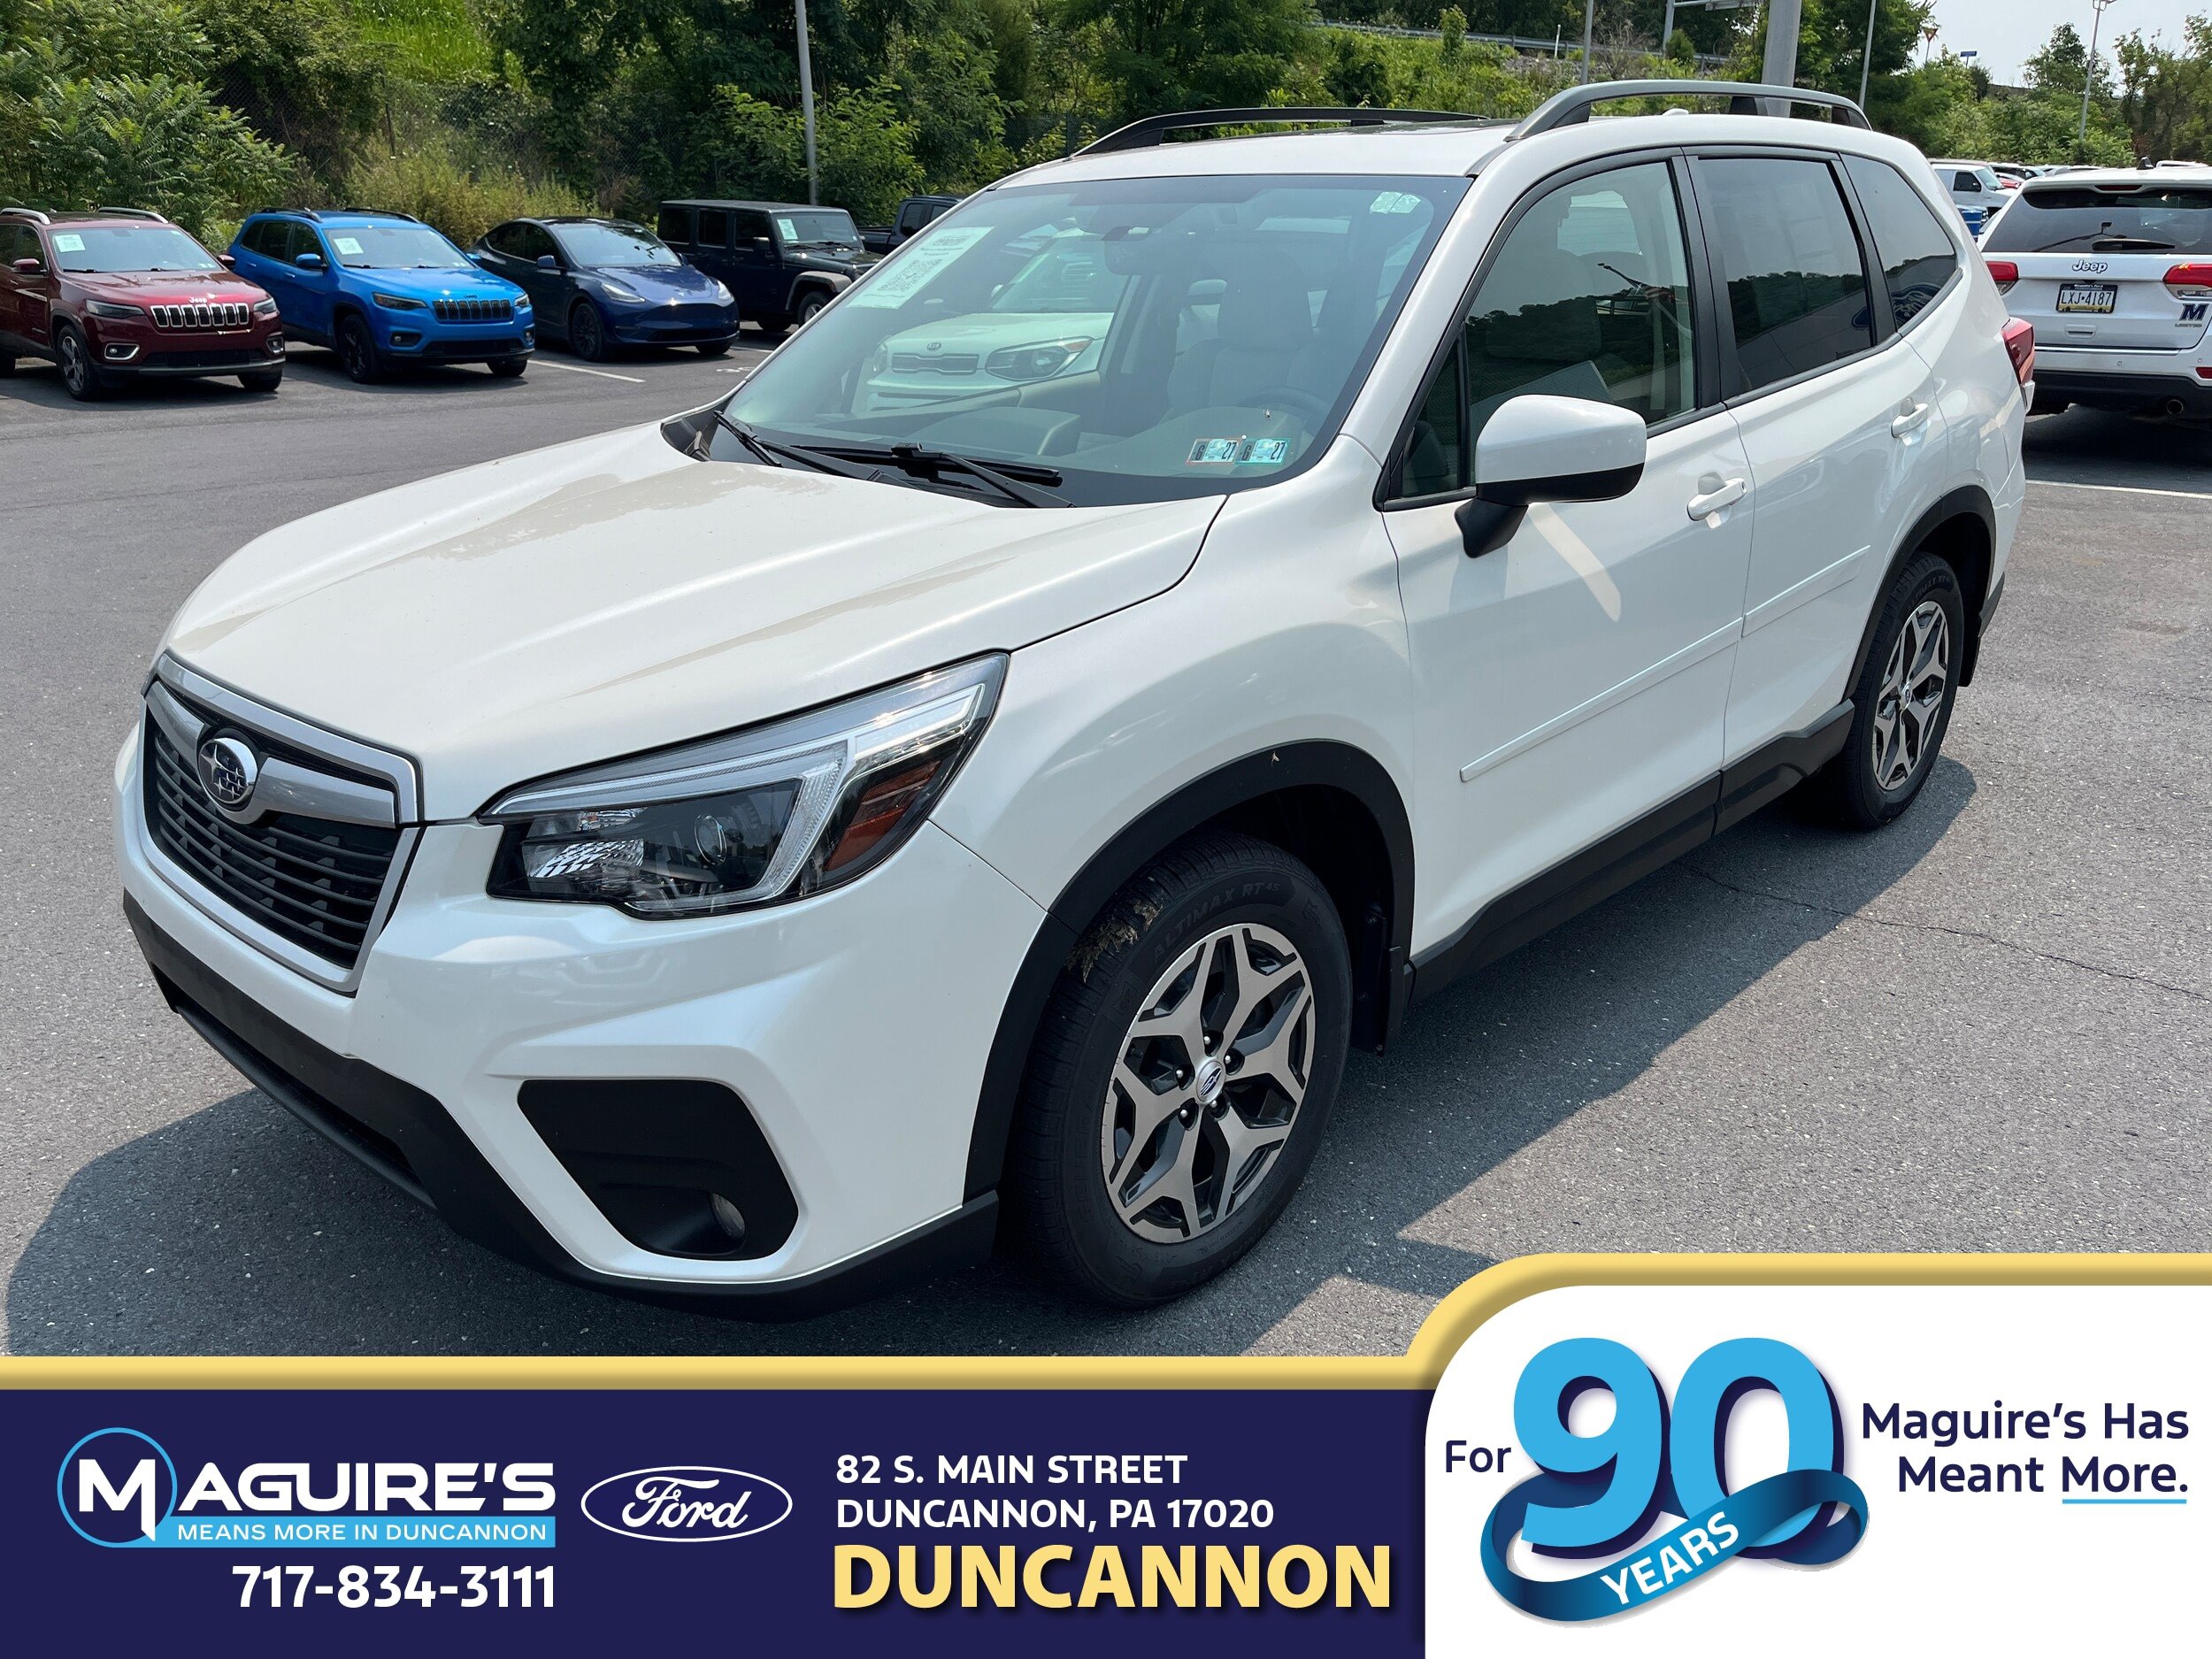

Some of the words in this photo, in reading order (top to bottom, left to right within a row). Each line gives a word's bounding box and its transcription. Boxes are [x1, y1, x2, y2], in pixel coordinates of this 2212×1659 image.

[2072, 260, 2108, 273] Jeep
[2179, 303, 2209, 320] M
[1221, 442, 1237, 461] 27
[1270, 442, 1286, 461] 27
[1154, 886, 1237, 964] ALTIMAX
